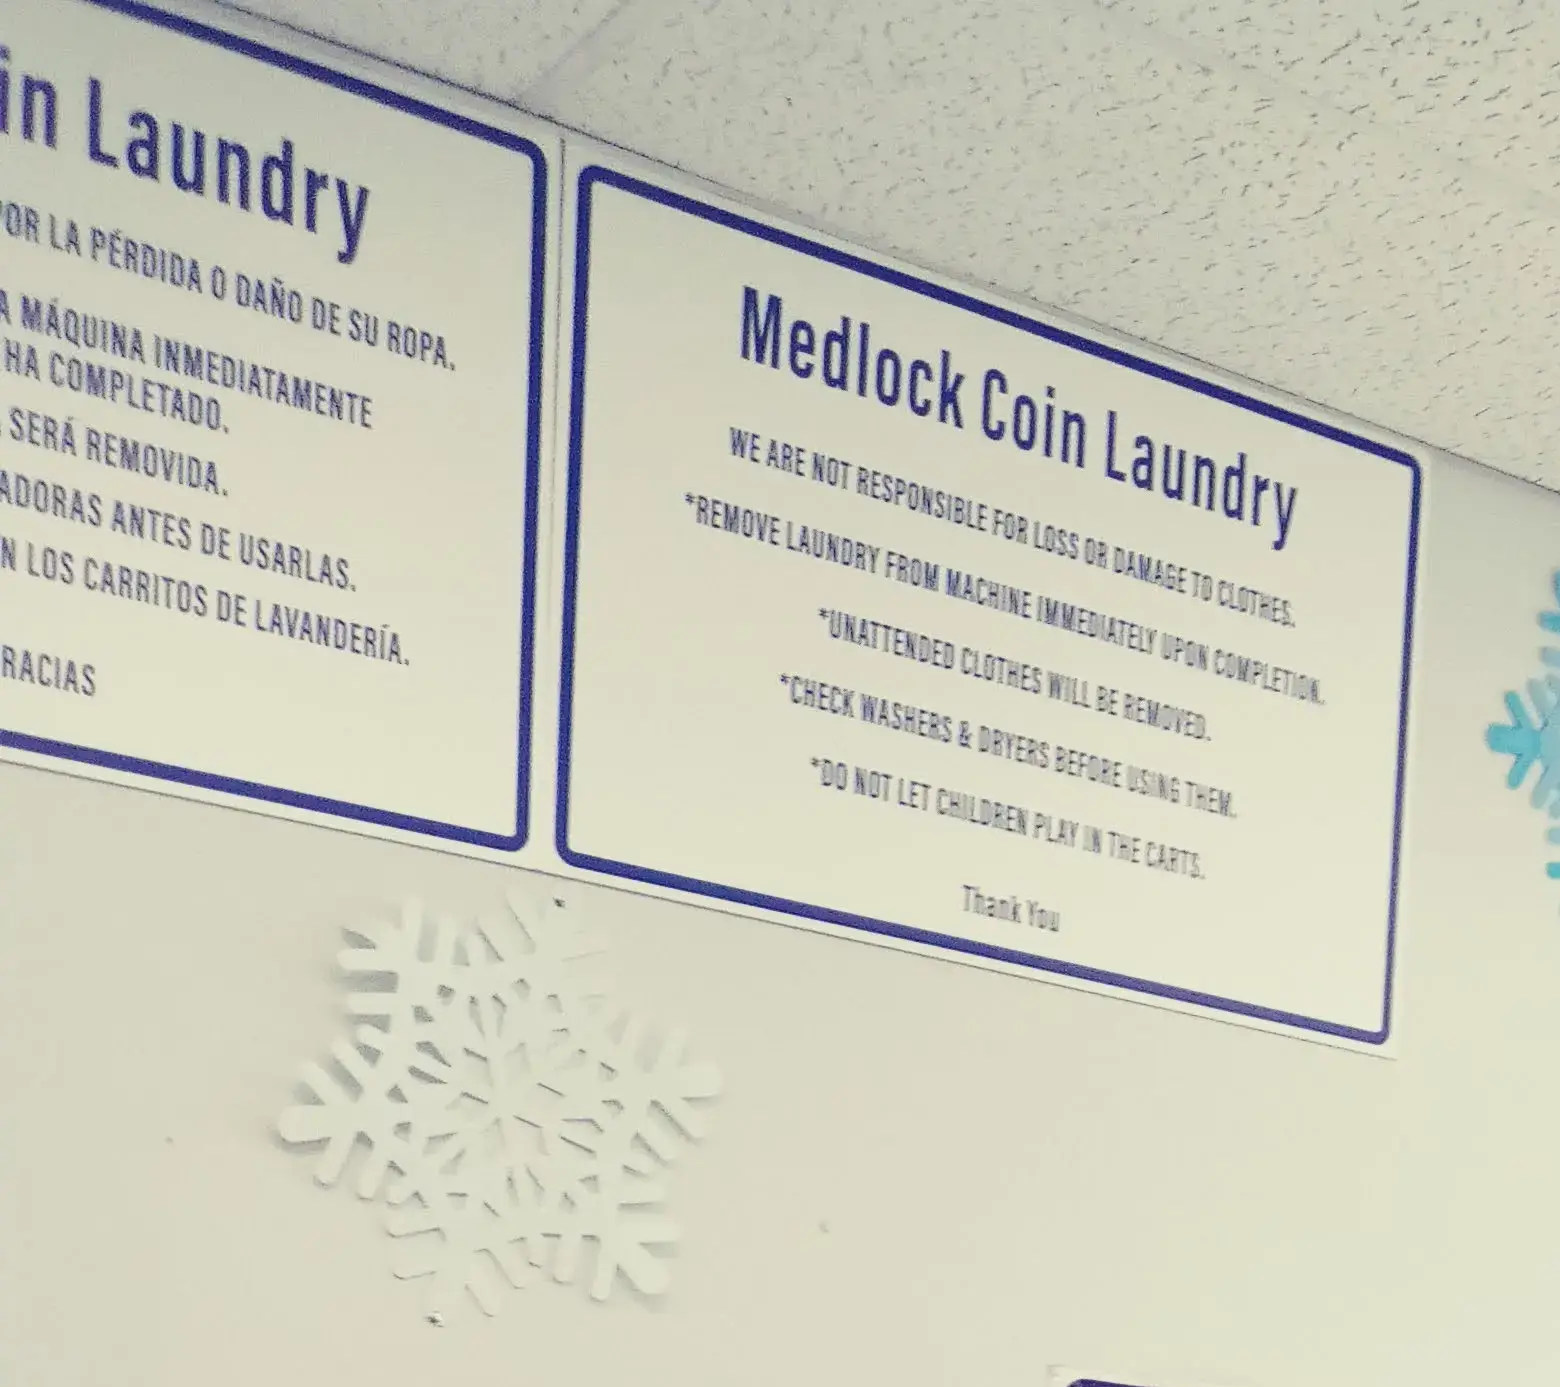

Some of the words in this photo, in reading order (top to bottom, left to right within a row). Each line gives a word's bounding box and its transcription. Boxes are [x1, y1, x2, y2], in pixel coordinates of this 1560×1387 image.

[88, 76, 369, 265] Laundry
[49, 213, 81, 257] LA
[90, 226, 203, 294] PÉRDIDA
[211, 265, 227, 300] O
[236, 272, 303, 325] DAÑO
[312, 297, 342, 337] DE
[349, 308, 379, 347] SU
[387, 320, 456, 371] ROPA.
[3, 337, 41, 381] HA
[49, 351, 230, 434] COMPLETADO.
[21, 294, 146, 365] MÁQUINA
[153, 333, 373, 429] INMEDIATAMENTE
[740, 285, 966, 429] Medlock
[982, 368, 1087, 469] Coin
[1104, 410, 1298, 551] Laundry
[8, 406, 78, 457] SERÁ
[85, 426, 228, 497] REMOVIDA.
[111, 500, 192, 551] ANTES
[200, 522, 232, 561] DE
[239, 532, 357, 592] USARLAS.
[729, 426, 760, 464] WE
[766, 438, 807, 478] ARE
[811, 452, 853, 490] NOT
[856, 465, 988, 532] RESPONSIBLE
[992, 508, 1029, 545] FOR
[1033, 521, 1080, 560] LOSS
[1083, 536, 1108, 570] OR
[1112, 546, 1188, 594] DAMAGE
[1191, 571, 1214, 602] TO
[1217, 579, 1296, 628] CLOTHES.
[26, 541, 74, 585] LOS
[83, 556, 208, 617] CARRITOS
[216, 589, 247, 627] DE
[255, 599, 409, 666] LAVANDERÍA.
[786, 520, 881, 574] LAUNDRY
[885, 550, 940, 592] FROM
[946, 567, 1033, 619] MACHINE
[1036, 595, 1158, 655] IMMEDIATELY
[1160, 631, 1210, 671] UPON
[1214, 647, 1327, 706] COMPLETION.
[1, 644, 96, 697] RACIAS
[960, 646, 1043, 694] CLOTHES
[1047, 669, 1092, 709] WILL
[1096, 685, 1119, 716] BE
[1122, 692, 1212, 742] REMOVED.
[860, 692, 952, 743] WASHERS
[957, 720, 973, 749] &
[978, 724, 1050, 769] DRYERS
[1054, 745, 1123, 788] BEFORE
[1127, 764, 1181, 804] USING
[1184, 781, 1238, 819] THEM.
[853, 765, 893, 802] NOT
[897, 777, 933, 812] LET
[936, 787, 1028, 836] CHILDREN
[1032, 812, 1080, 849] PLAY
[1082, 824, 1103, 855] IN
[1107, 830, 1141, 864] THE
[1145, 840, 1206, 880] CARTS.
[961, 883, 1022, 924] Thank
[1026, 899, 1061, 933] You
